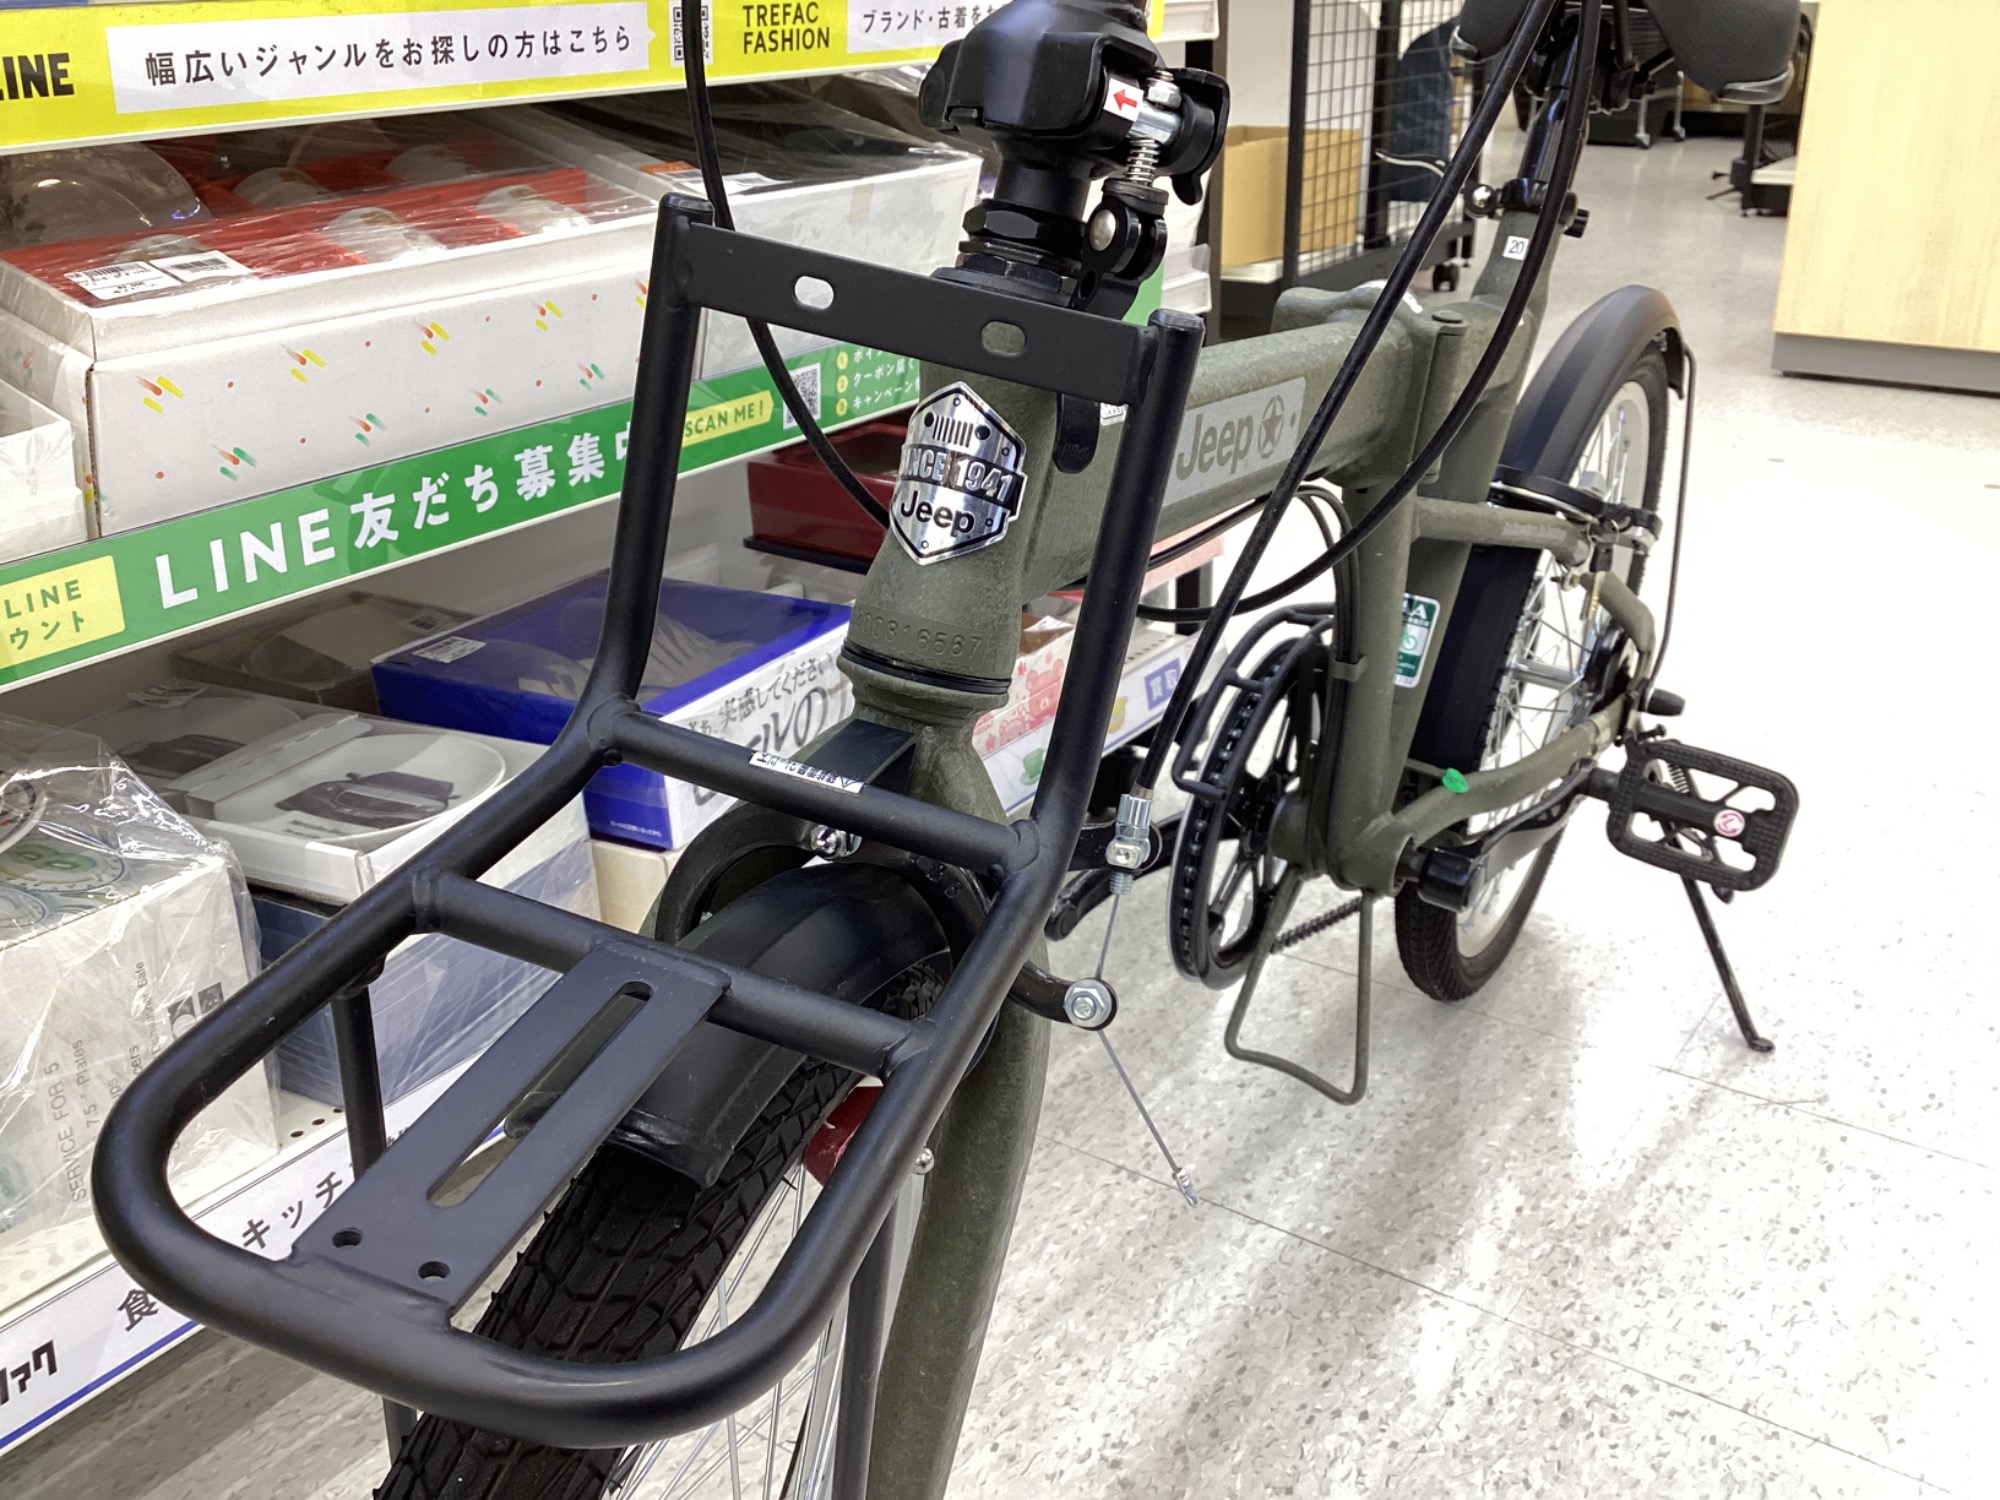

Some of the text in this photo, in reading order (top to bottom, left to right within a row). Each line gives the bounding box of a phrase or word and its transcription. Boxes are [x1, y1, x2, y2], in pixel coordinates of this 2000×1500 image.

[743, 1, 819, 28] TREFAC
[145, 25, 630, 87] 幅広いジャンルをお探しの方はこちら
[743, 27, 830, 54] FASHION
[0, 53, 74, 100] INE
[1508, 240, 1525, 254] 20
[685, 409, 728, 437] SCAN
[1176, 413, 1254, 480] Jeep
[955, 458, 1013, 502] 1941
[901, 490, 975, 537] Jeep
[4, 579, 82, 619] LINE
[9, 610, 85, 650] ウント
[72, 1039, 91, 1087] Plates
[44, 1062, 87, 1202] SERVICE FOR 5
[242, 1165, 353, 1251] キッチ
